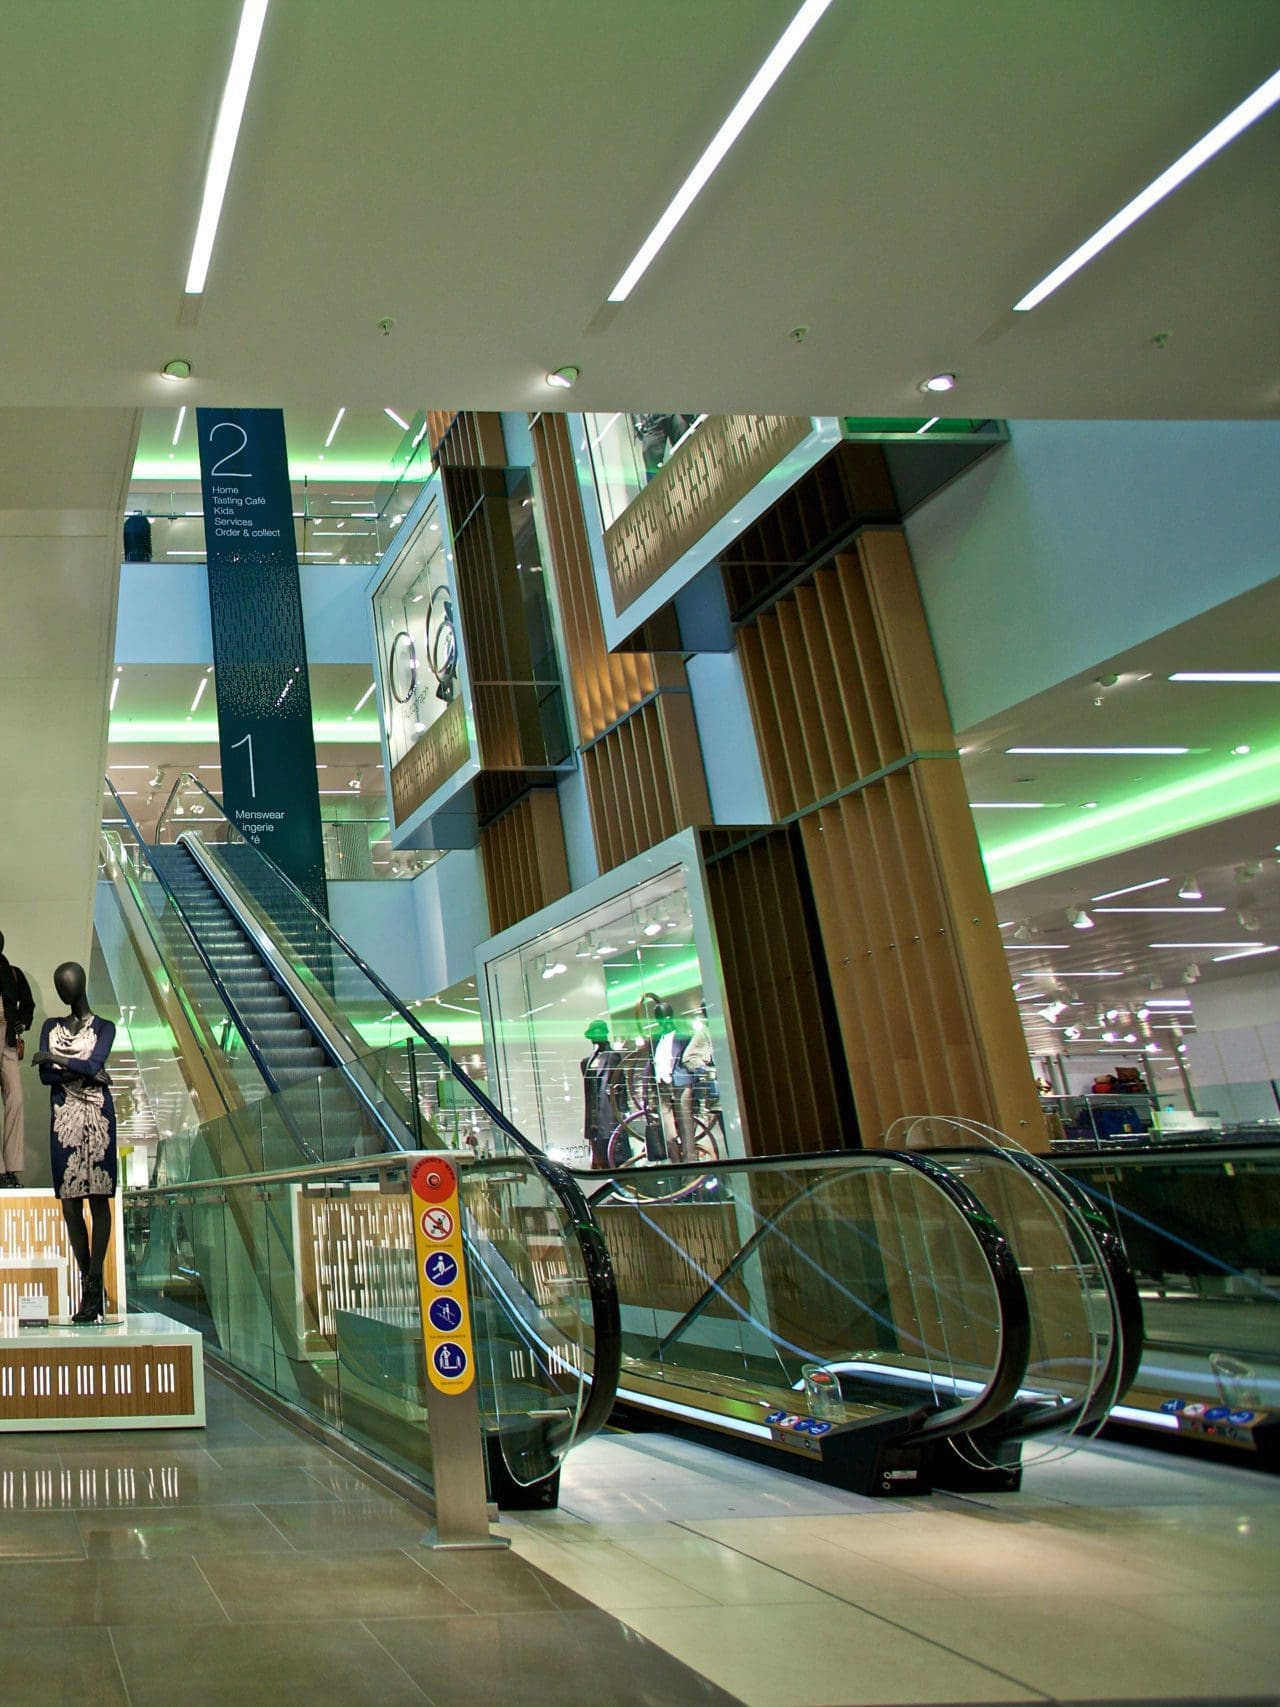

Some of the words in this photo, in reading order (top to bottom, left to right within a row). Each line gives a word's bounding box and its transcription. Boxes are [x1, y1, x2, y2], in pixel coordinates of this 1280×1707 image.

[209, 422, 253, 477] 2
[212, 486, 239, 494] Home
[213, 497, 243, 506] Tasting
[245, 497, 266, 505] Café
[214, 507, 234, 515] Kids
[214, 518, 253, 526] Services
[215, 528, 241, 537] Order
[243, 528, 250, 537] &
[251, 528, 281, 537] collect
[231, 733, 256, 798] 1
[235, 810, 285, 819] Menswear
[241, 822, 275, 833] ingerie
